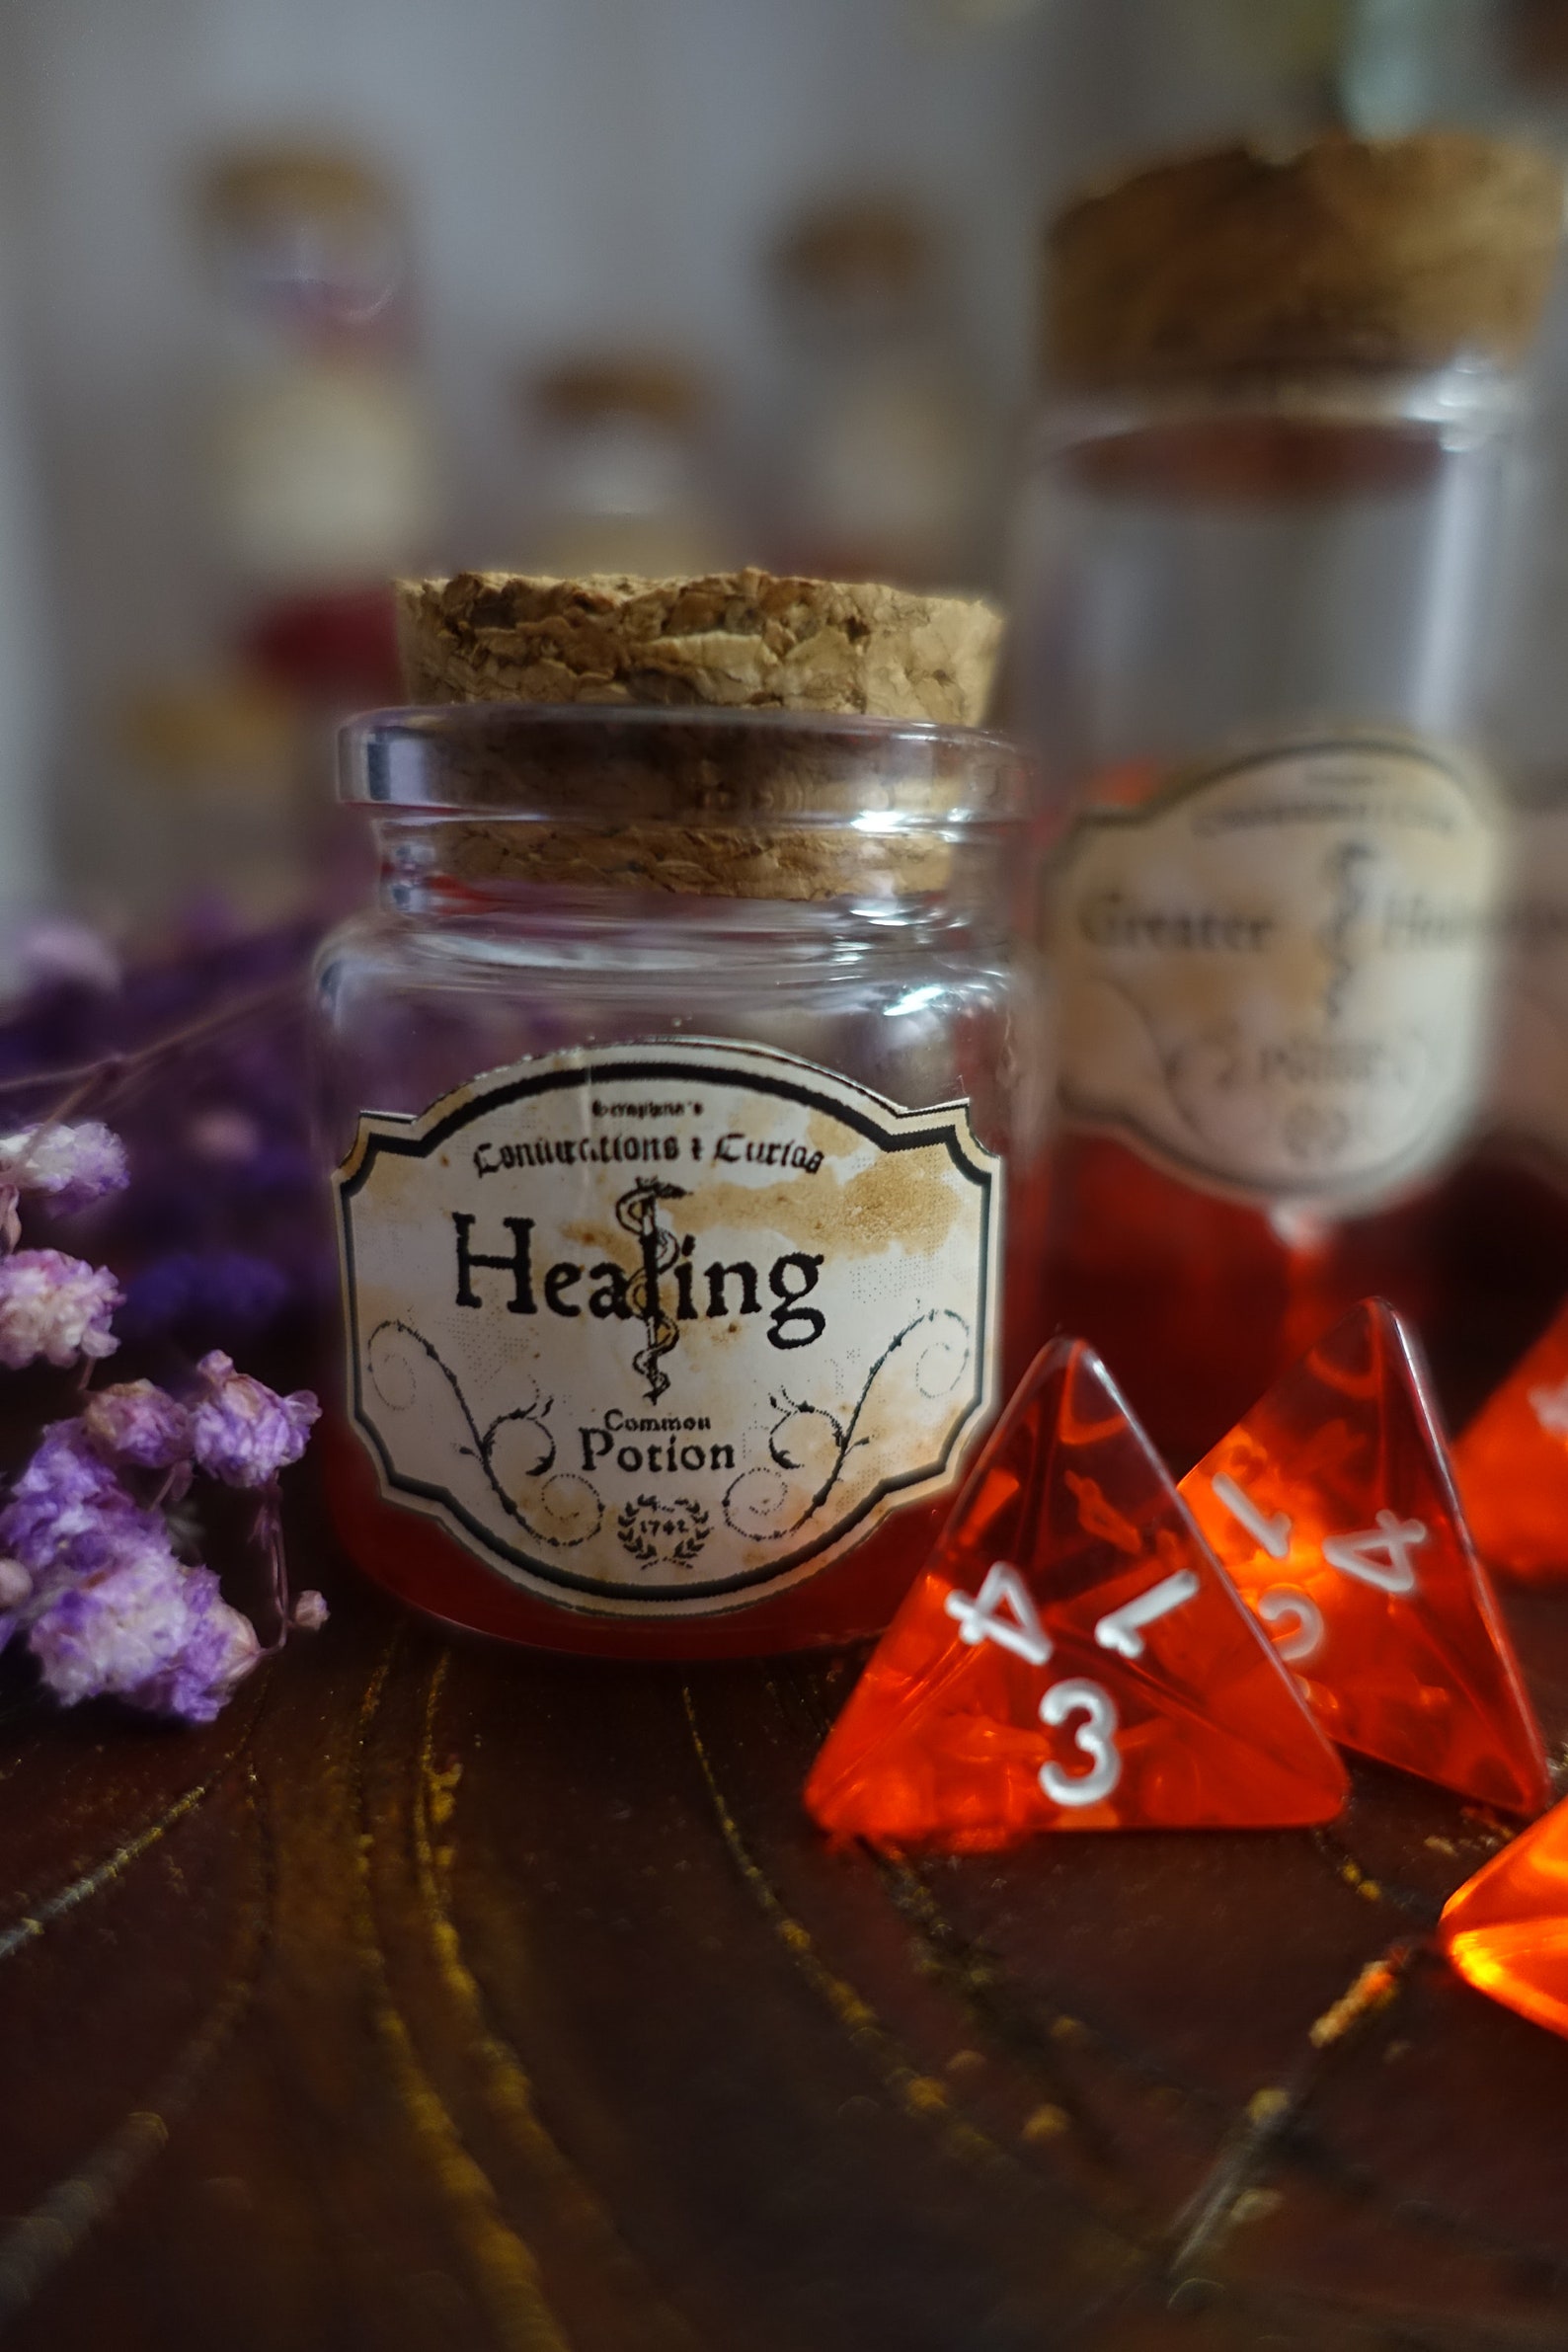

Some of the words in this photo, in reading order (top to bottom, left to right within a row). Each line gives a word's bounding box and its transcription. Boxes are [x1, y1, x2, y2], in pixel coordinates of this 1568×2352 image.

[713, 1134, 825, 1175] Curios
[451, 1212, 826, 1350] Healing
[579, 1427, 736, 1472] Potion
[604, 1408, 711, 1431] Common
[945, 1561, 1053, 1665] 4
[1039, 1680, 1122, 1807] 3
